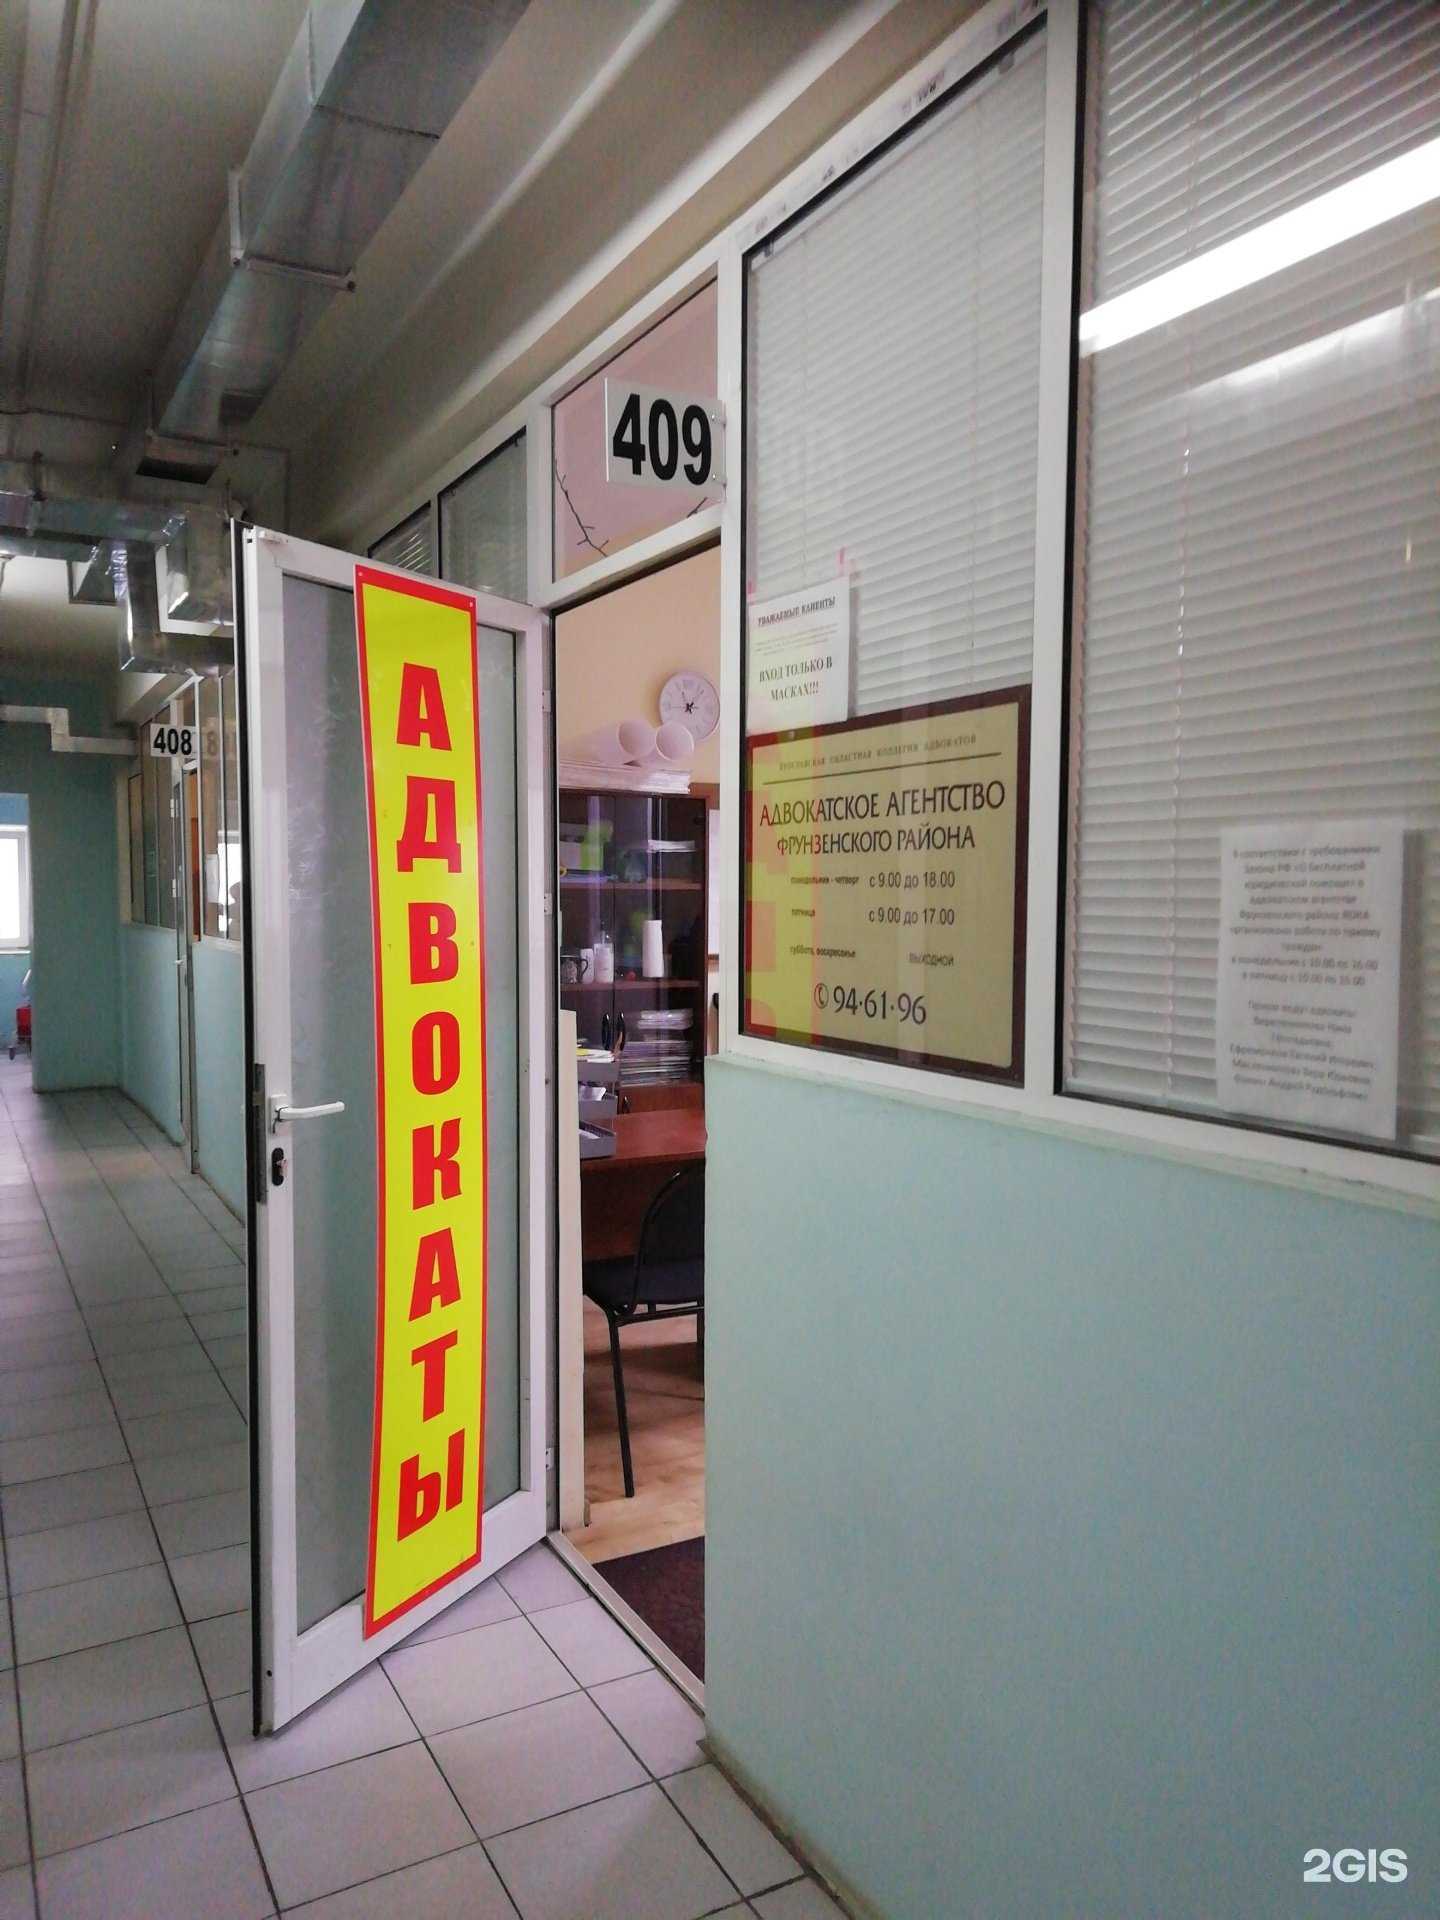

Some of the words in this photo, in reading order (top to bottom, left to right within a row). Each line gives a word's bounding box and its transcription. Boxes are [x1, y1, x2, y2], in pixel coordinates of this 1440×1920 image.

[613, 394, 711, 485] 409
[759, 666, 783, 682] ВХОД
[785, 658, 824, 679] ТОЛЬКО
[826, 656, 833, 669] В
[770, 681, 820, 701] МАСКАХ!!!
[153, 728, 192, 755] 408
[760, 794, 880, 827] АДВОКАТСКОЕ
[886, 780, 1005, 817] АГЕНТСТВО
[777, 829, 892, 856] ФРУНЗЕНСКОГО
[897, 823, 976, 850] РАЙОНА
[869, 876, 876, 887] с
[878, 872, 901, 888] 9.00
[904, 875, 919, 889] до
[923, 871, 956, 888] 18.00
[869, 911, 876, 923] с
[878, 907, 901, 923] 9.00
[903, 911, 918, 926] до
[923, 908, 955, 925] 17.00
[396, 662, 466, 1541] АДВОКАТЫ
